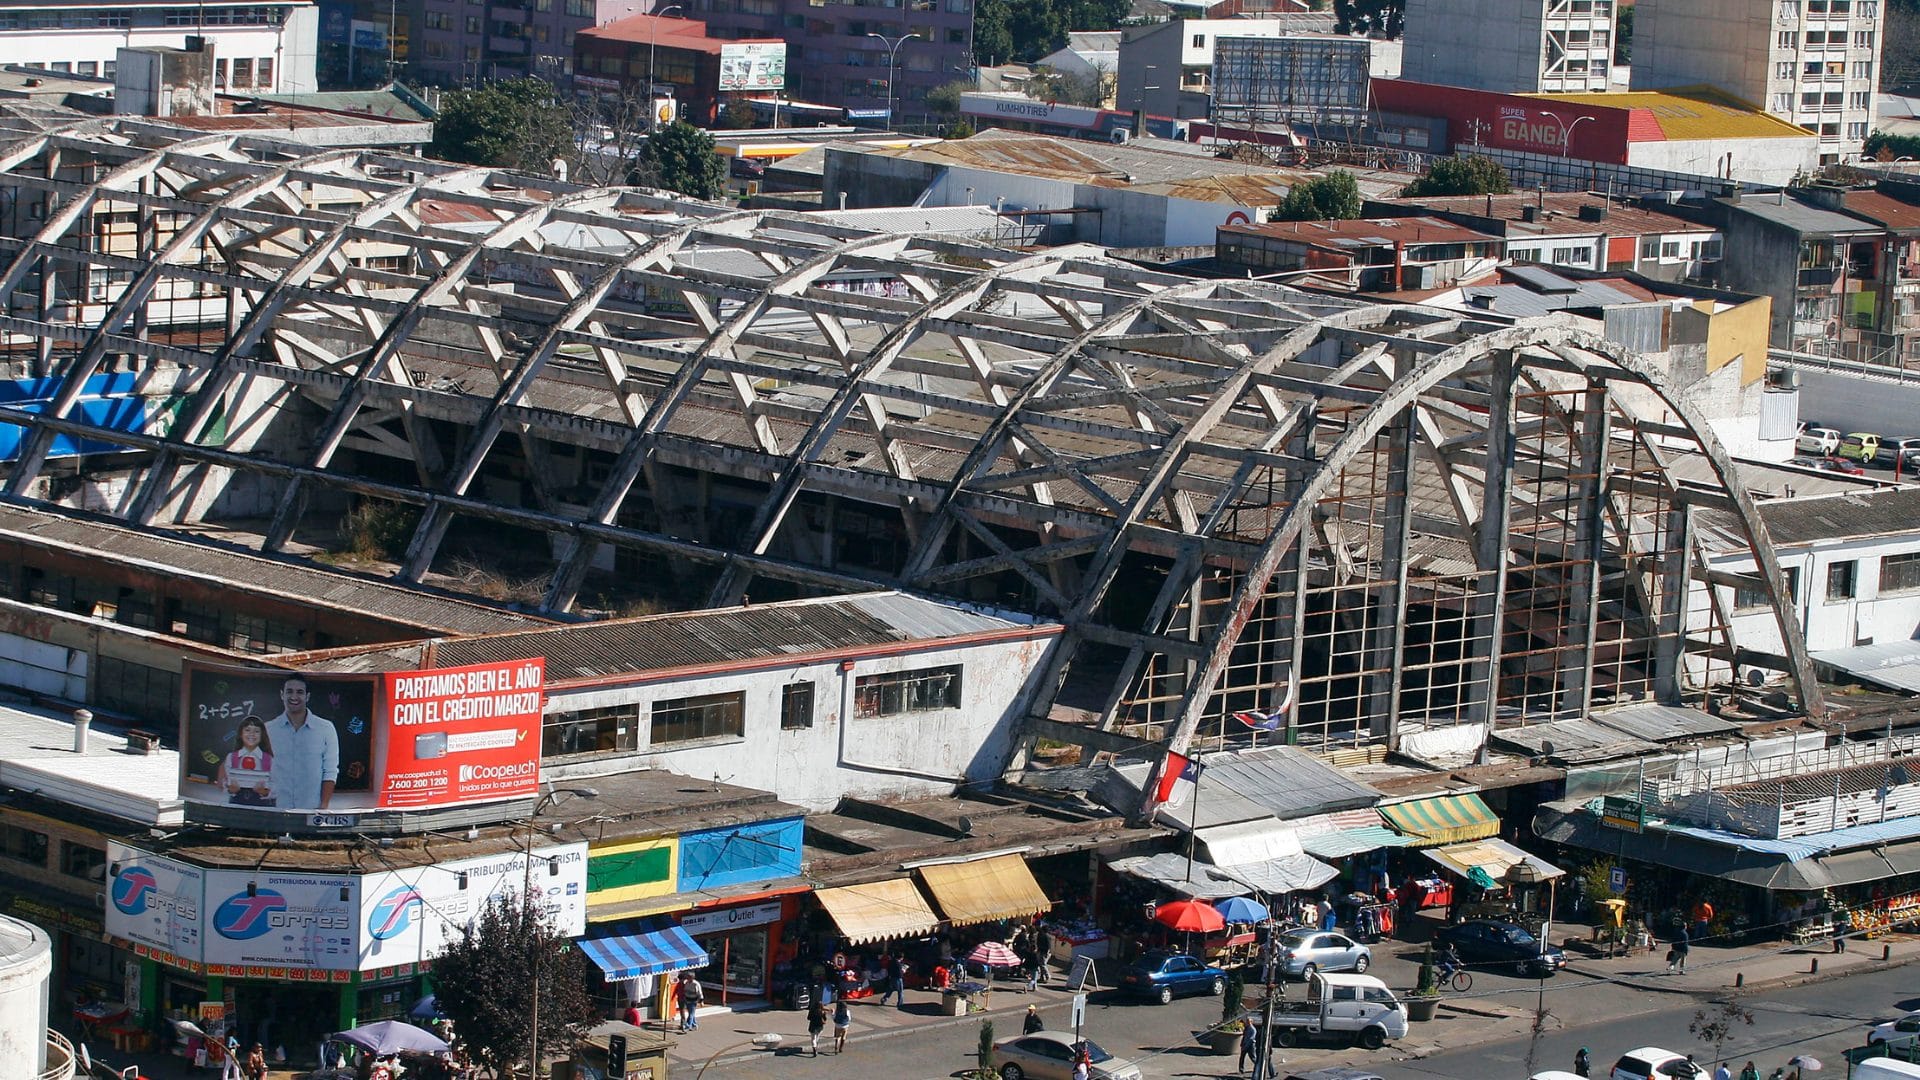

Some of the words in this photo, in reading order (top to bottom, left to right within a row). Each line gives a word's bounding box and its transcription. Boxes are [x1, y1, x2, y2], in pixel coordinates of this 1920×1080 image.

[996, 103, 1025, 114] KUMHO
[1025, 105, 1048, 117] TIRES
[1500, 106, 1525, 117] SUPER
[1504, 120, 1569, 147] GANGA
[395, 673, 465, 700] PARTAMOS
[467, 670, 496, 694] BIEN
[498, 669, 512, 692] EL
[515, 664, 541, 689] AÑO
[199, 700, 255, 720] 2+5=7
[394, 702, 424, 726] CON
[425, 700, 441, 723] EL
[442, 695, 493, 722] CRÉDITO
[494, 692, 540, 717] MARZO!
[473, 760, 536, 780] Coopeuch
[395, 780, 412, 789] 600
[413, 779, 428, 788] 200
[430, 777, 448, 787] 1200
[459, 783, 480, 793] Unidos
[480, 782, 492, 791] por
[492, 781, 499, 789] lo
[499, 781, 513, 789] que
[325, 815, 349, 826] CBS
